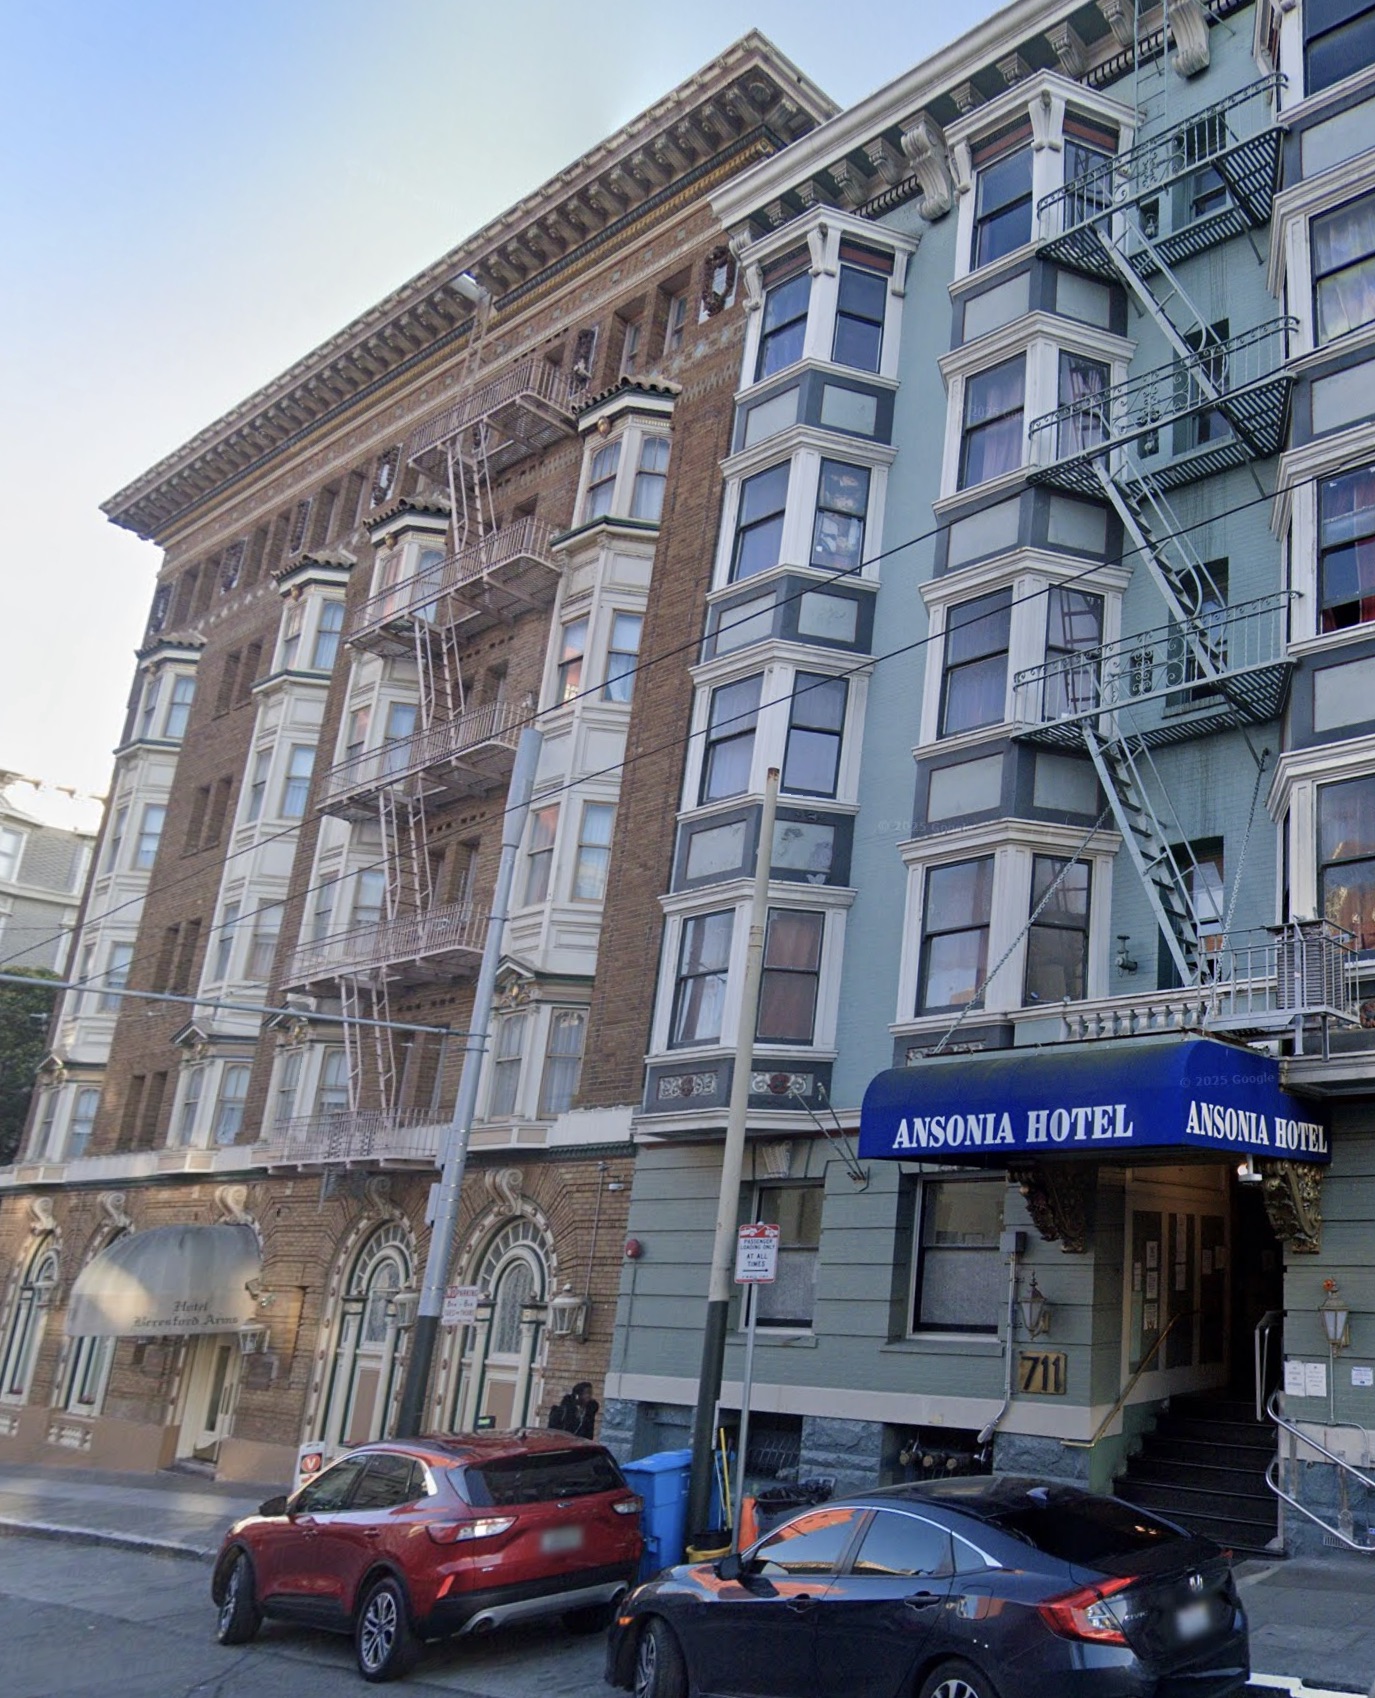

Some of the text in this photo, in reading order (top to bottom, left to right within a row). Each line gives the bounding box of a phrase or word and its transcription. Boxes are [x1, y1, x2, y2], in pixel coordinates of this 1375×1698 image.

[892, 1104, 1133, 1149] ANSONIA HOTEL
[1186, 1100, 1328, 1153] ANSONIA HOTEL
[133, 1314, 238, 1328] Beresford Arms
[173, 1300, 209, 1312] Hotel
[1021, 1354, 1061, 1392] 711
